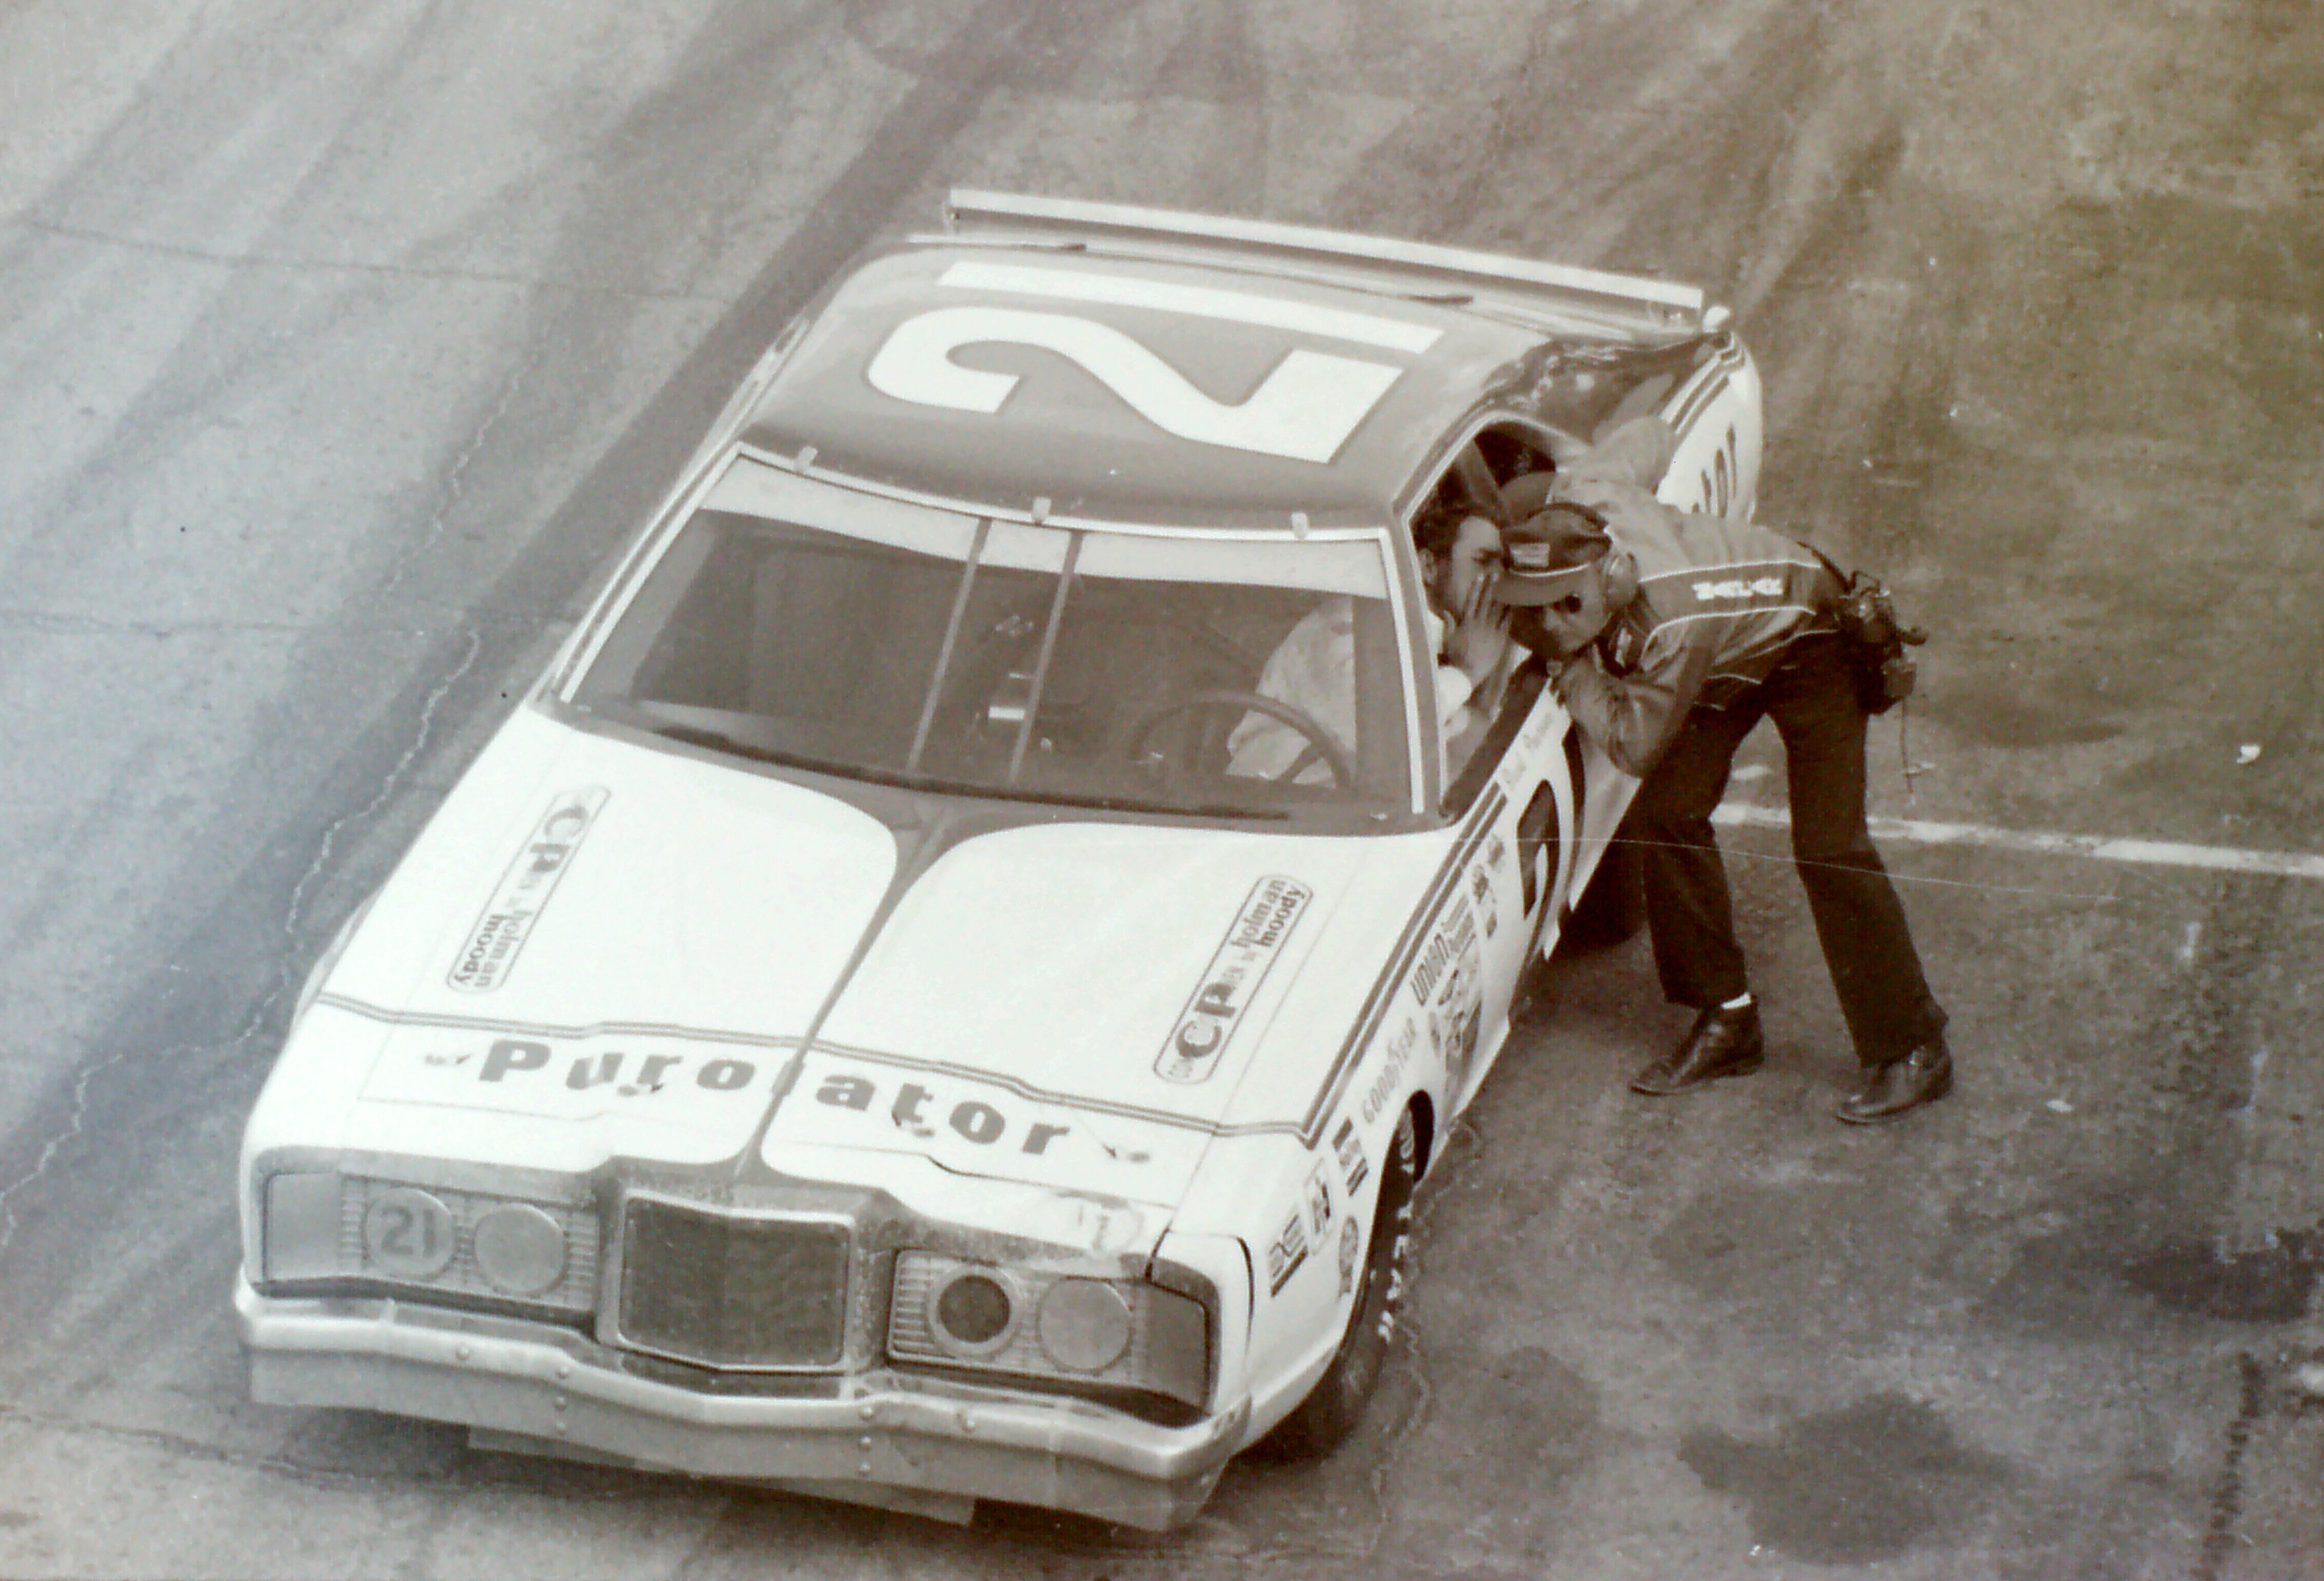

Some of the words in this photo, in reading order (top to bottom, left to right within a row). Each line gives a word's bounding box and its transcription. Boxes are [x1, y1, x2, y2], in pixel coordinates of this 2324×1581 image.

[868, 261, 1444, 464] 21
[1229, 879, 1286, 948] holman
[1257, 885, 1305, 947] moody
[454, 914, 504, 983] moody
[379, 1204, 438, 1259] 21
